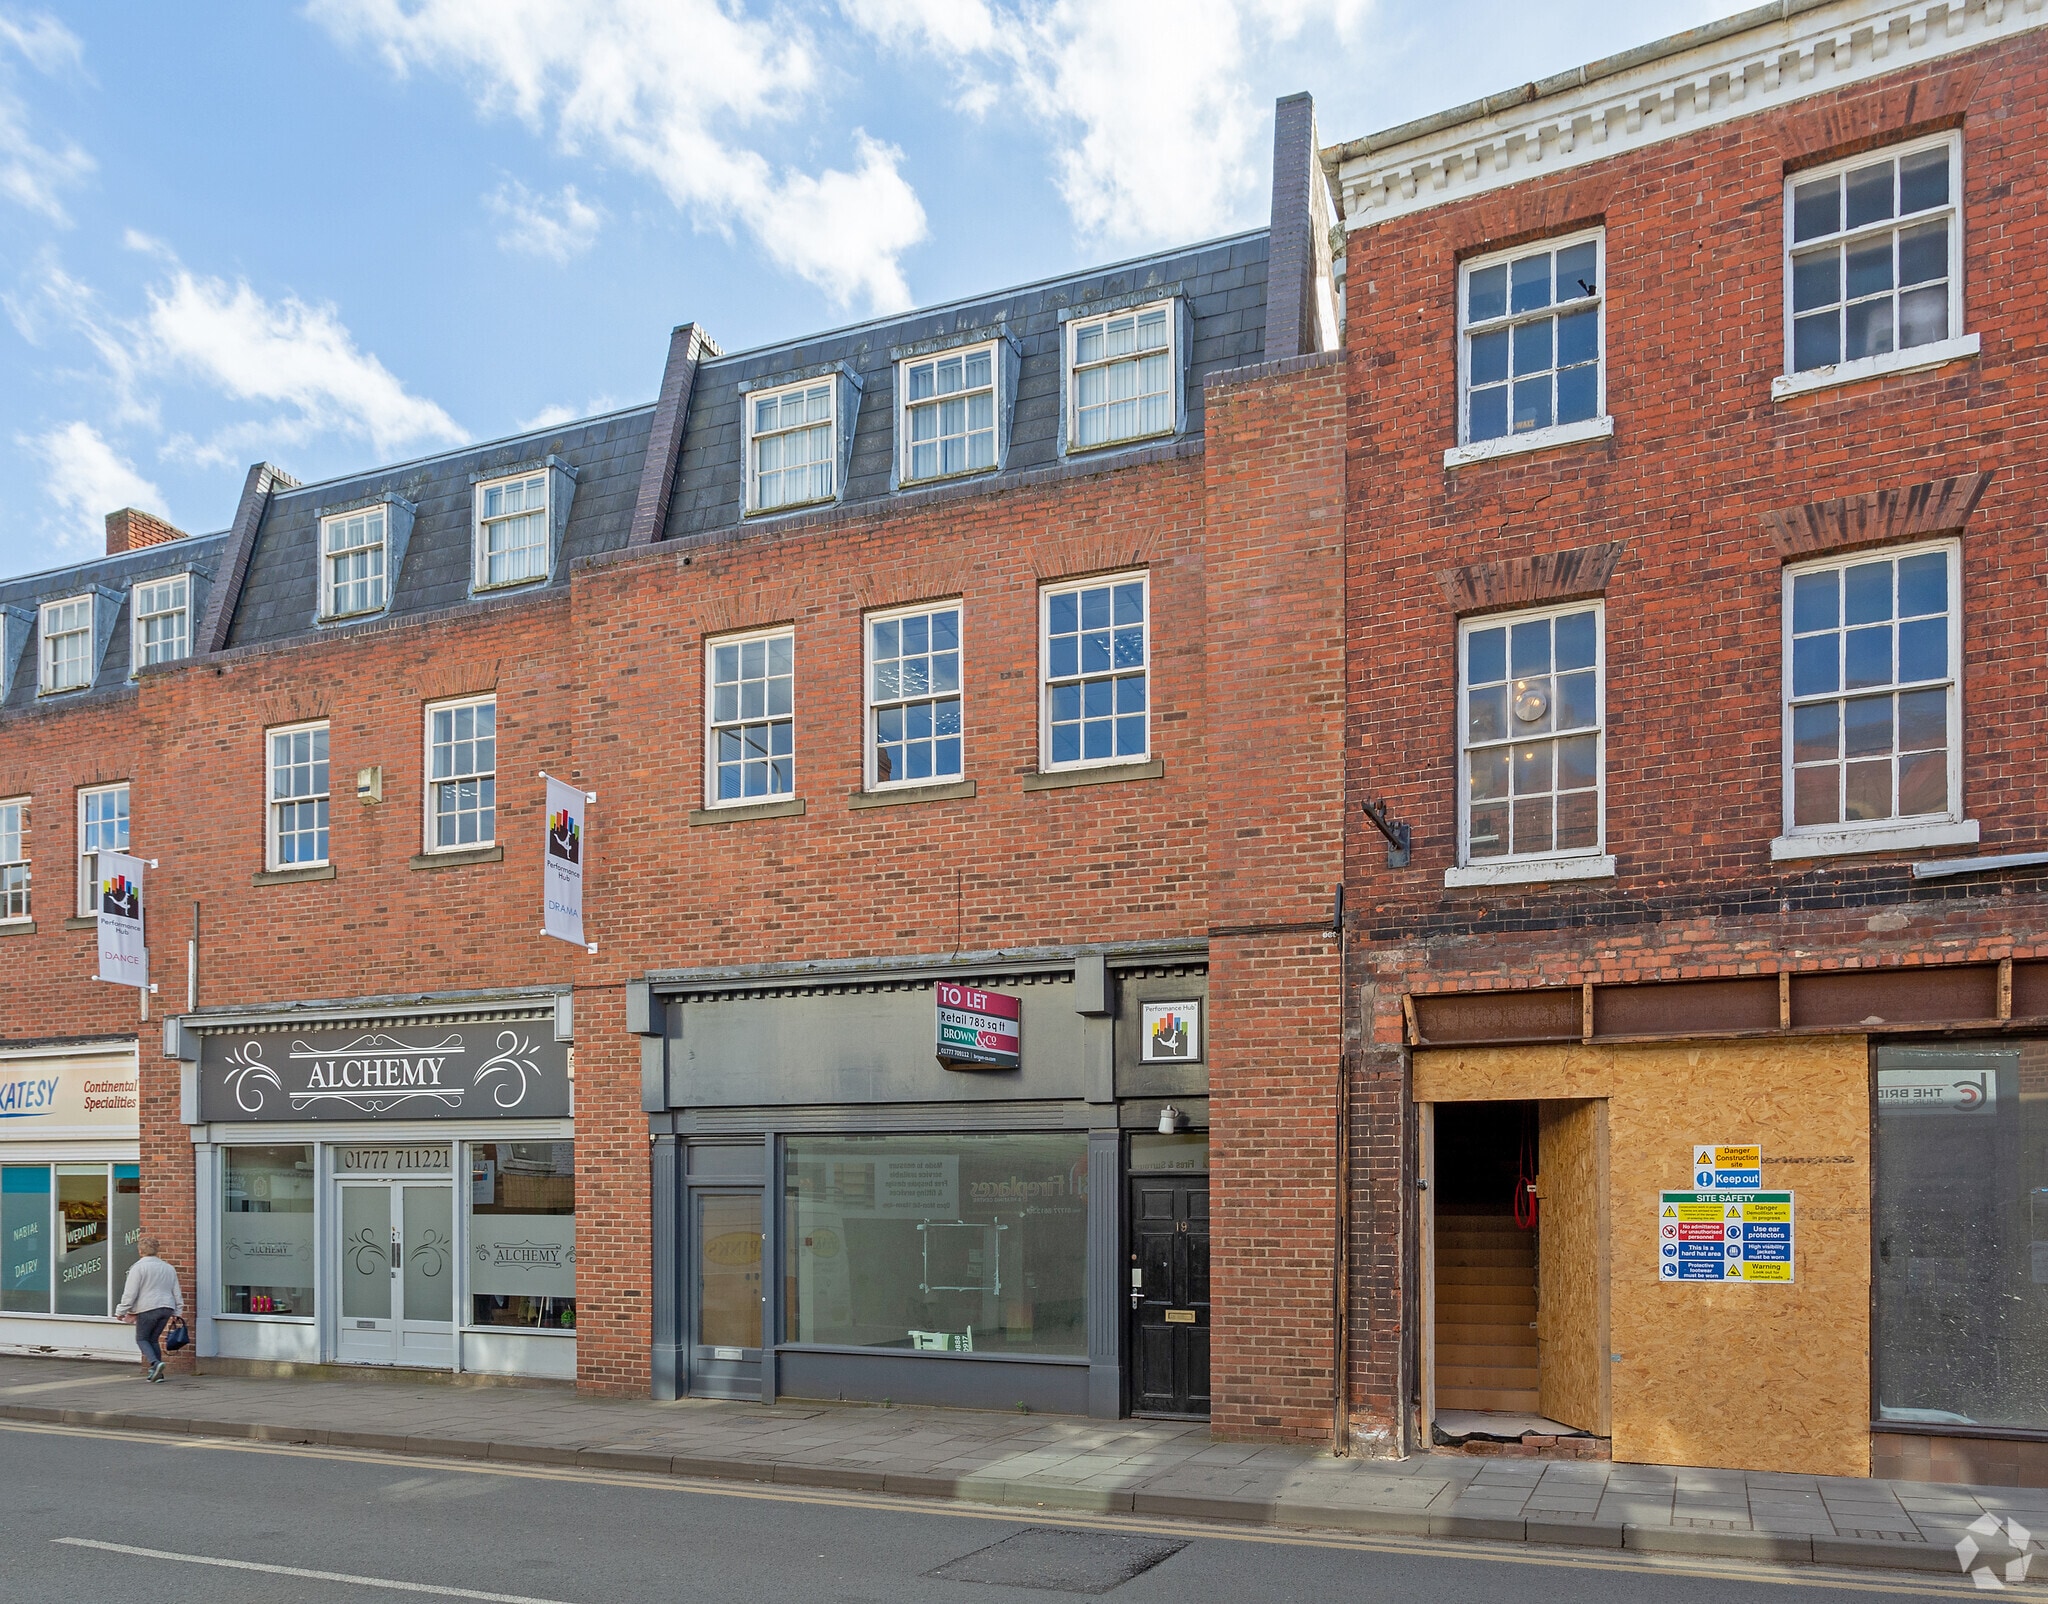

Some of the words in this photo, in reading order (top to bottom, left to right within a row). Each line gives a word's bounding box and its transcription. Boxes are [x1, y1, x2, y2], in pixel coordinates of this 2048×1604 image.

[546, 860, 580, 878] Performance
[558, 872, 570, 882] Hub
[548, 900, 578, 918] DRAMA
[100, 918, 140, 932] Performance
[116, 927, 130, 936] Hub
[105, 952, 140, 964] DANCE
[941, 986, 962, 1005] TO
[966, 992, 988, 1010] LET
[940, 1011, 967, 1025] Retail
[969, 1016, 985, 1028] 783
[987, 1022, 997, 1032] sq
[999, 1021, 1006, 1032] ft
[306, 1057, 446, 1088] ALCHEMY
[84, 1079, 138, 1093] Continental
[84, 1096, 136, 1112] Specialities
[344, 1150, 389, 1169] 01777
[397, 1150, 450, 1168] 711221
[1716, 1174, 1742, 1184] Keep
[1742, 1174, 1758, 1183] out
[67, 1222, 98, 1244] WĘDLINY
[1176, 1221, 1188, 1232] 19
[249, 1245, 288, 1254] ALCHEMY
[496, 1249, 559, 1262] ALCHEMY
[14, 1258, 38, 1278] DAIRY
[62, 1257, 102, 1282] SAUSAGES
